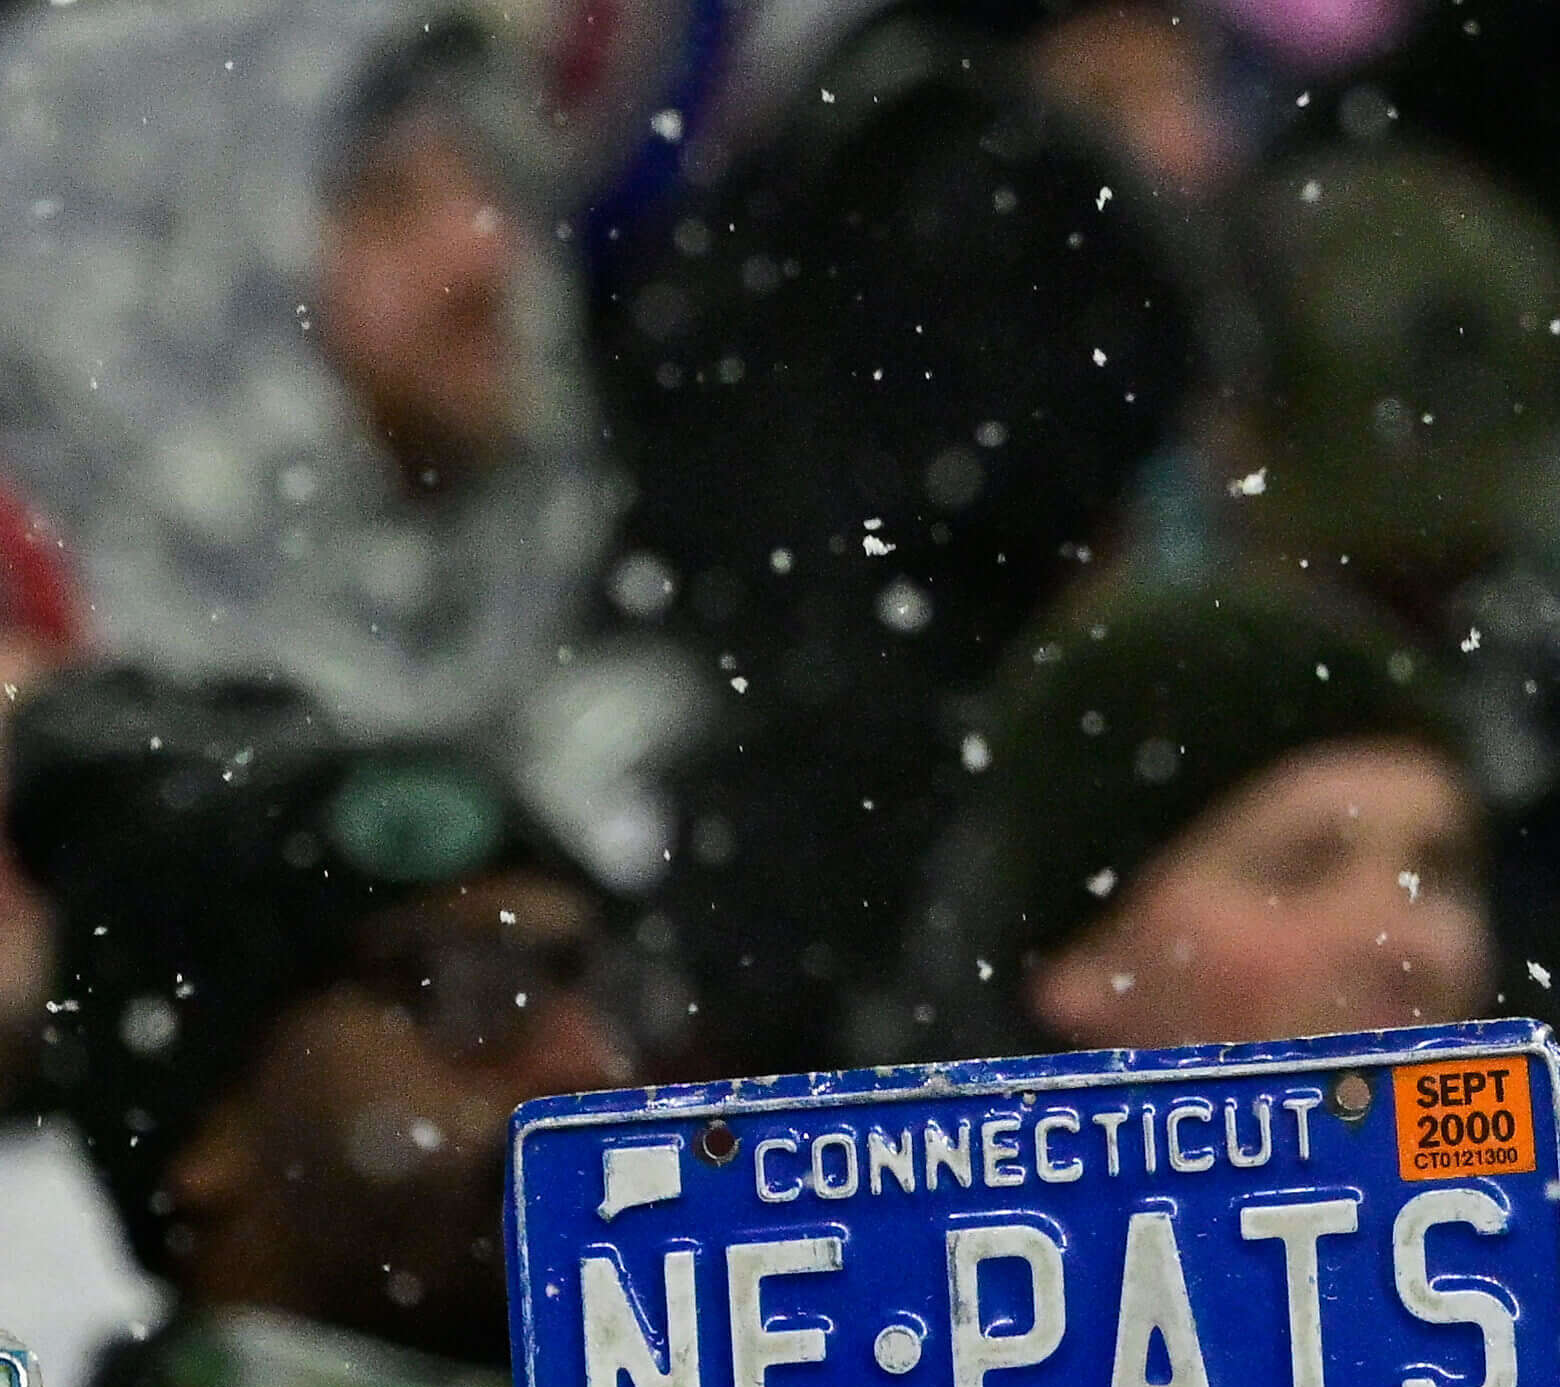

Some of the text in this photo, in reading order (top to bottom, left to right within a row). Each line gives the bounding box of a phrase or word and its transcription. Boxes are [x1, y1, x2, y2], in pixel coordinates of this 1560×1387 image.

[1416, 1070, 1510, 1108] SEPT
[1417, 1110, 1516, 1149] 2000
[753, 1096, 1324, 1204] CONNECTICUT
[1414, 1147, 1519, 1170] CT0121300
